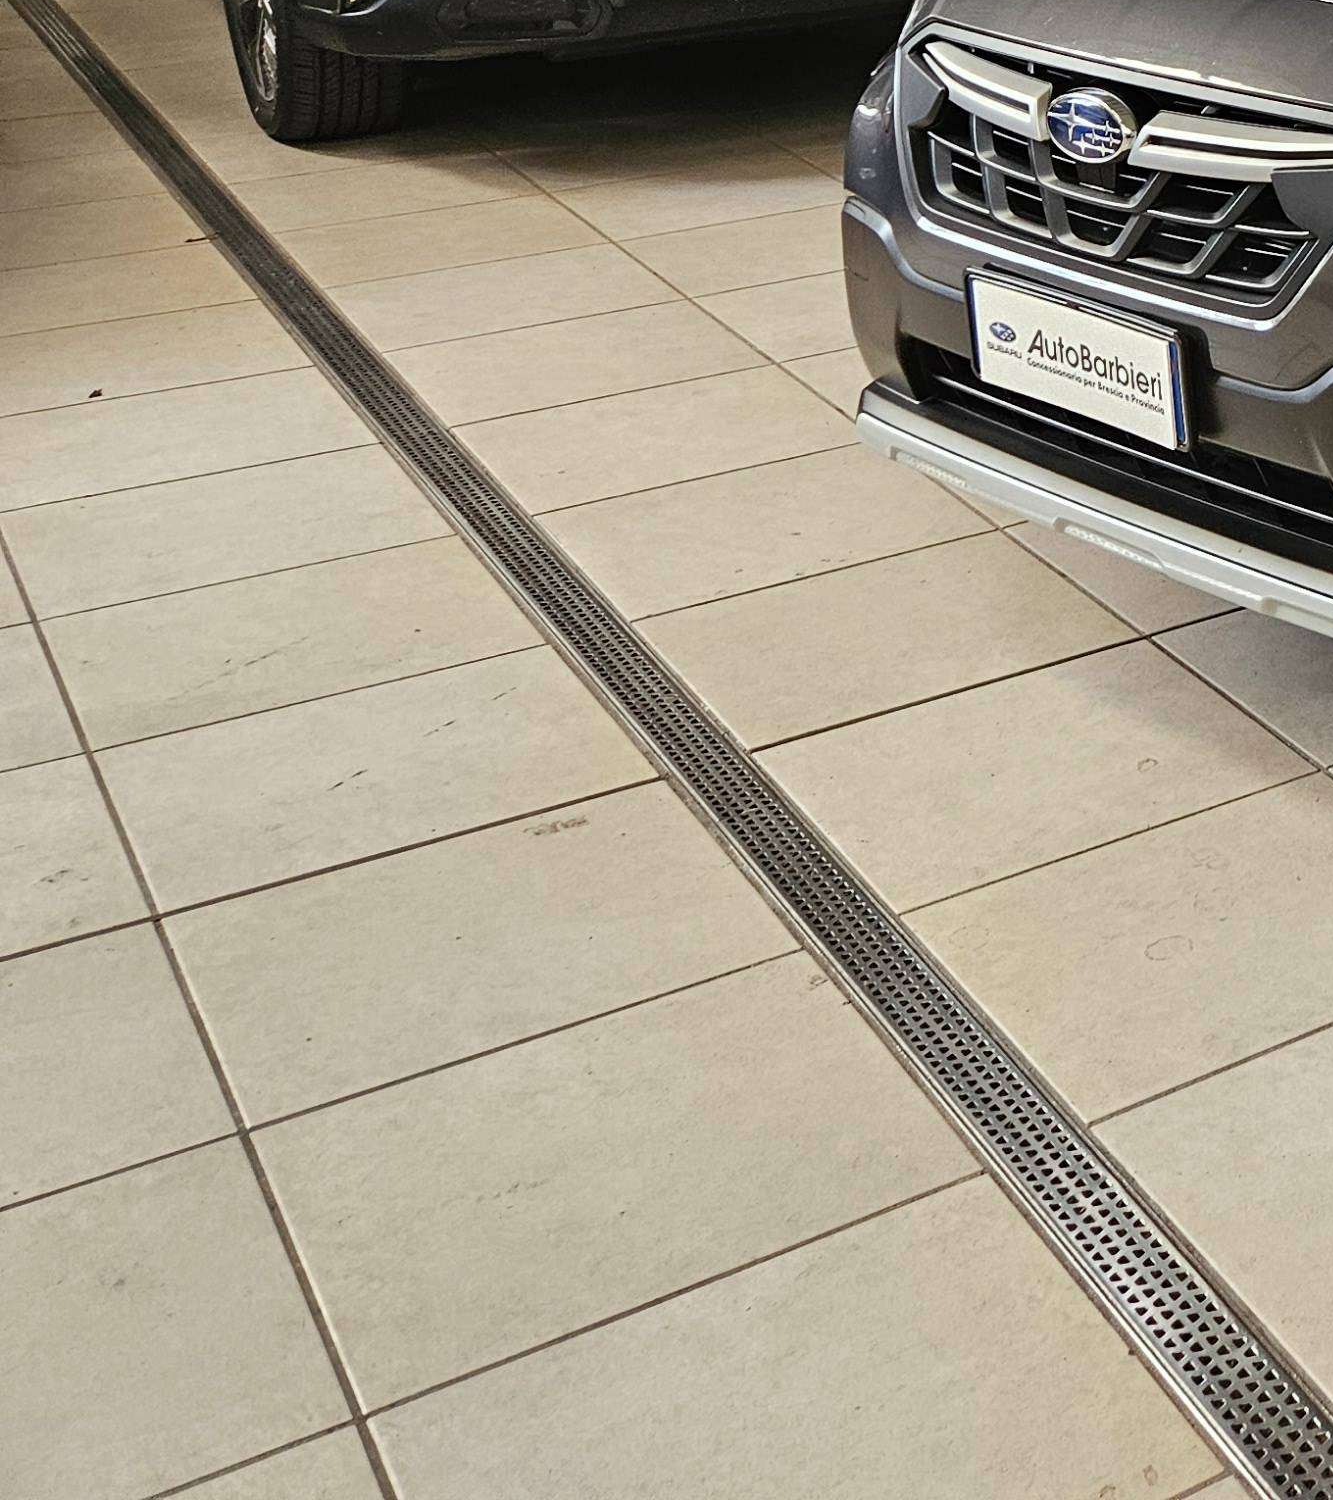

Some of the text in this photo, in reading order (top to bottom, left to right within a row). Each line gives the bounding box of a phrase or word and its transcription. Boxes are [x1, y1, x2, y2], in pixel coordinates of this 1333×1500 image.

[986, 341, 1022, 359] SUBARU
[1027, 329, 1163, 401] AutoBarbieri
[1083, 378, 1097, 388] per
[1097, 381, 1124, 399] Brescia
[1131, 393, 1165, 416] Provincia
